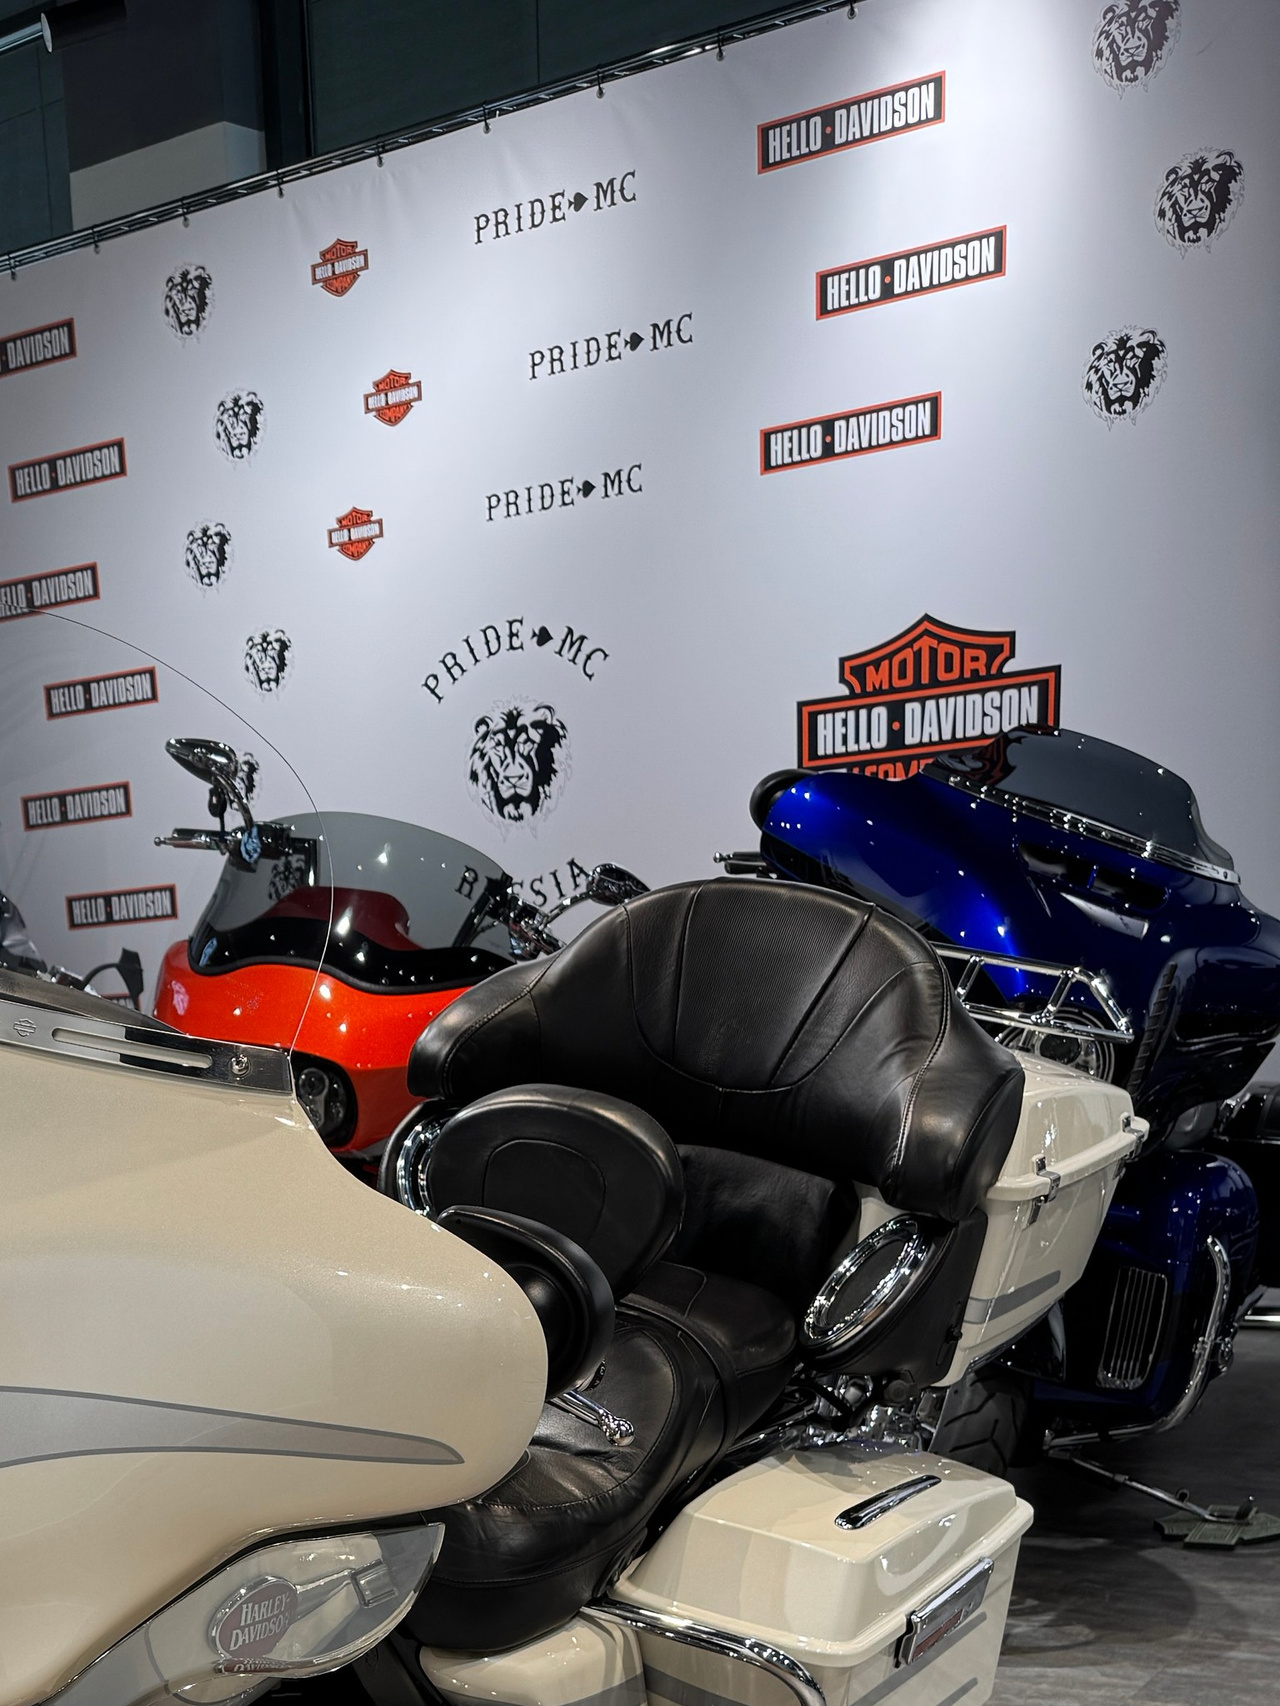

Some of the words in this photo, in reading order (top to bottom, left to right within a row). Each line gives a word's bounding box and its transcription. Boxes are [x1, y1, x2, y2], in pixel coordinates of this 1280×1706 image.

[769, 116, 821, 163] HELLO
[834, 82, 934, 145] DAVIDSON
[473, 189, 566, 245] PRIDE
[593, 169, 636, 211] MC
[826, 265, 881, 310] HELLO
[894, 236, 995, 294] DAVIDSON
[6, 326, 70, 369] DAVIDSON
[529, 329, 622, 380] PRIDE
[650, 312, 693, 351] MC
[770, 424, 822, 467] HELLO
[834, 401, 931, 453] DAVIDSON
[15, 463, 50, 496] HELLO
[56, 445, 120, 486] DAVIDSON
[486, 476, 575, 522] PRIDE
[601, 463, 643, 499] MC
[31, 569, 94, 607] DAVIDSON
[421, 616, 524, 704] PRIDE
[553, 626, 610, 681] MC
[865, 635, 987, 692] MOTOR
[50, 684, 85, 714] HELLO
[90, 673, 152, 708] DAVIDSON
[817, 706, 888, 756] HELLO
[904, 685, 1039, 746] DAVIDSON
[28, 798, 61, 826] HELLO
[66, 788, 126, 820] DAVIDSON
[72, 897, 106, 925] HELLO
[111, 890, 172, 921] DAVIDSON
